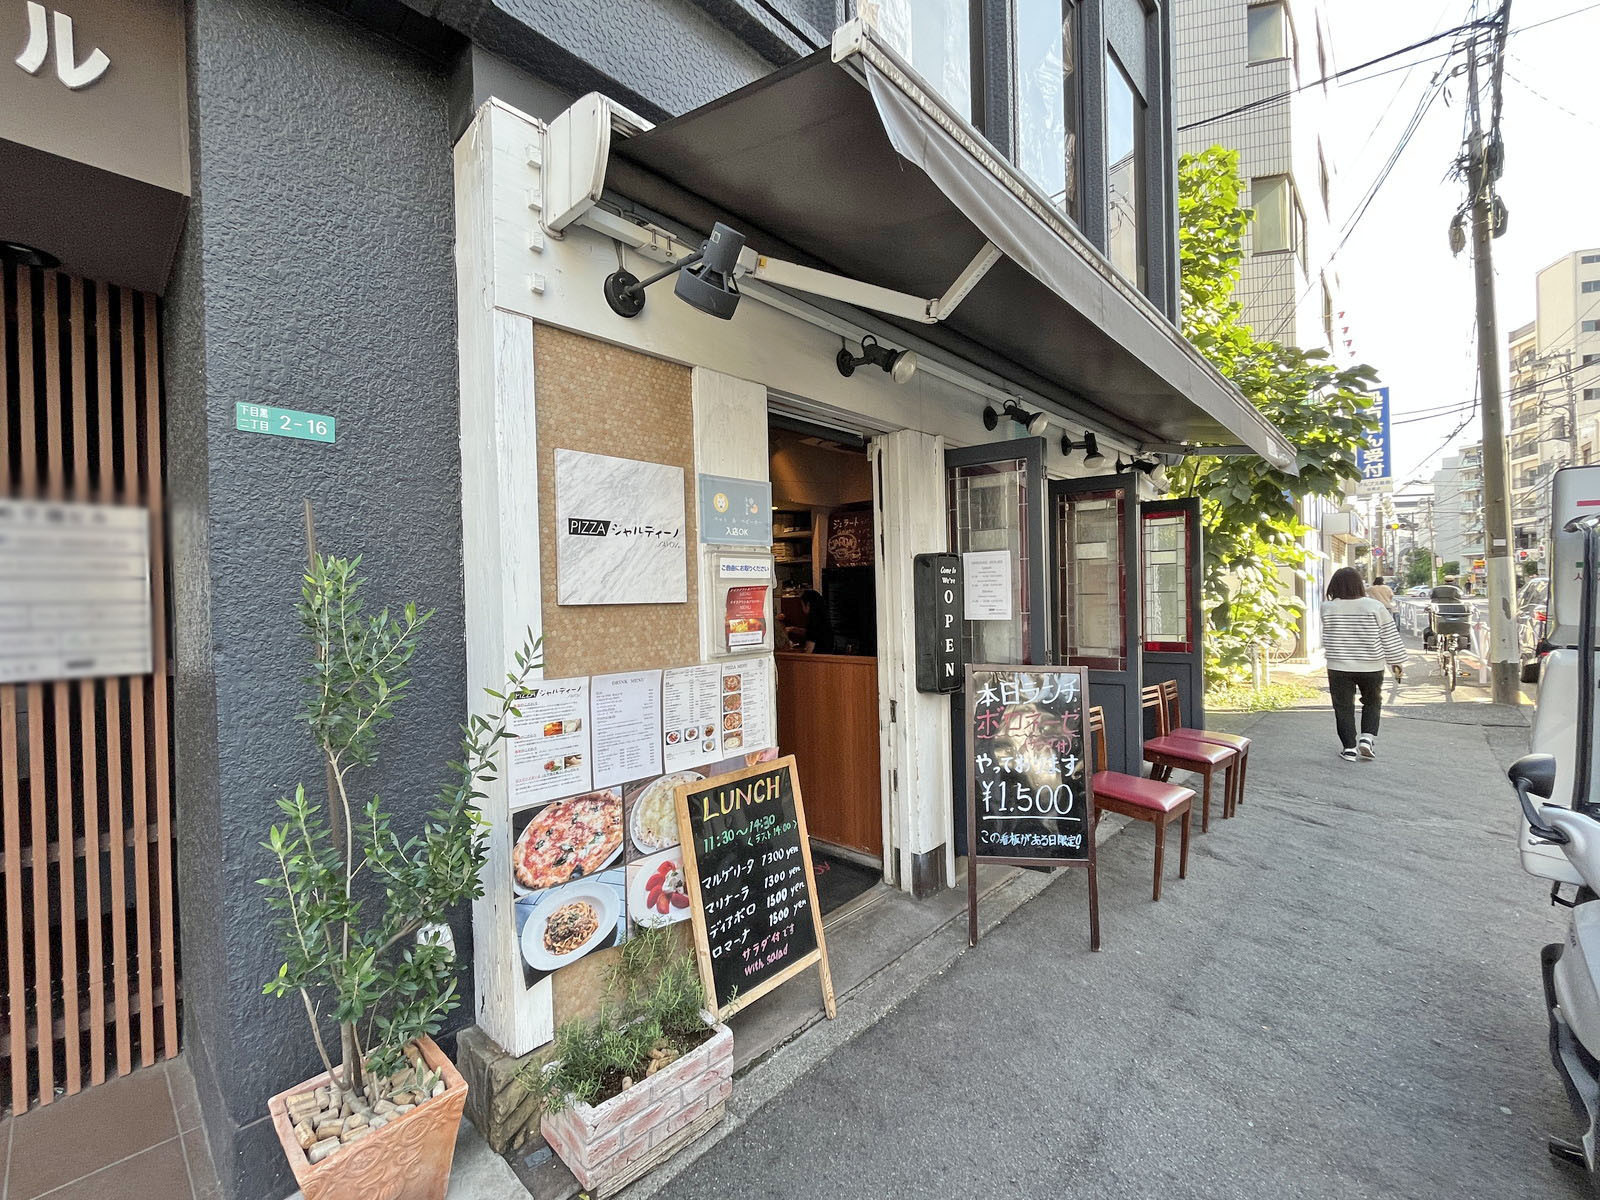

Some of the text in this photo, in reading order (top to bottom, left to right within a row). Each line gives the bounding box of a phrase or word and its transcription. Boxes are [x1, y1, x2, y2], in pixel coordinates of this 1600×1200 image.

[15, 1, 111, 88] ル
[239, 405, 269, 418] 下目黒
[239, 419, 269, 431] 二丁目
[280, 415, 327, 436] 2-16
[570, 520, 679, 538] PIZZA シャルティーノ
[721, 564, 770, 572] ご自由にお取りください
[940, 565, 952, 575] Come
[944, 589, 955, 677] OPEN
[540, 686, 581, 696] シャルティーノ
[976, 679, 1080, 707] 本日ランチ
[977, 706, 1081, 737] ボロネーゼ
[703, 776, 780, 822] LUNCH
[702, 846, 799, 889] マルゲリータ 1300 yen
[705, 885, 750, 914] マリナーラ
[764, 872, 785, 889] 1300
[788, 865, 801, 879] yen
[709, 881, 805, 939] ディアボロ 1500 yen
[712, 899, 807, 959] ロマーナ 1500 yen
[766, 943, 788, 965] salad
